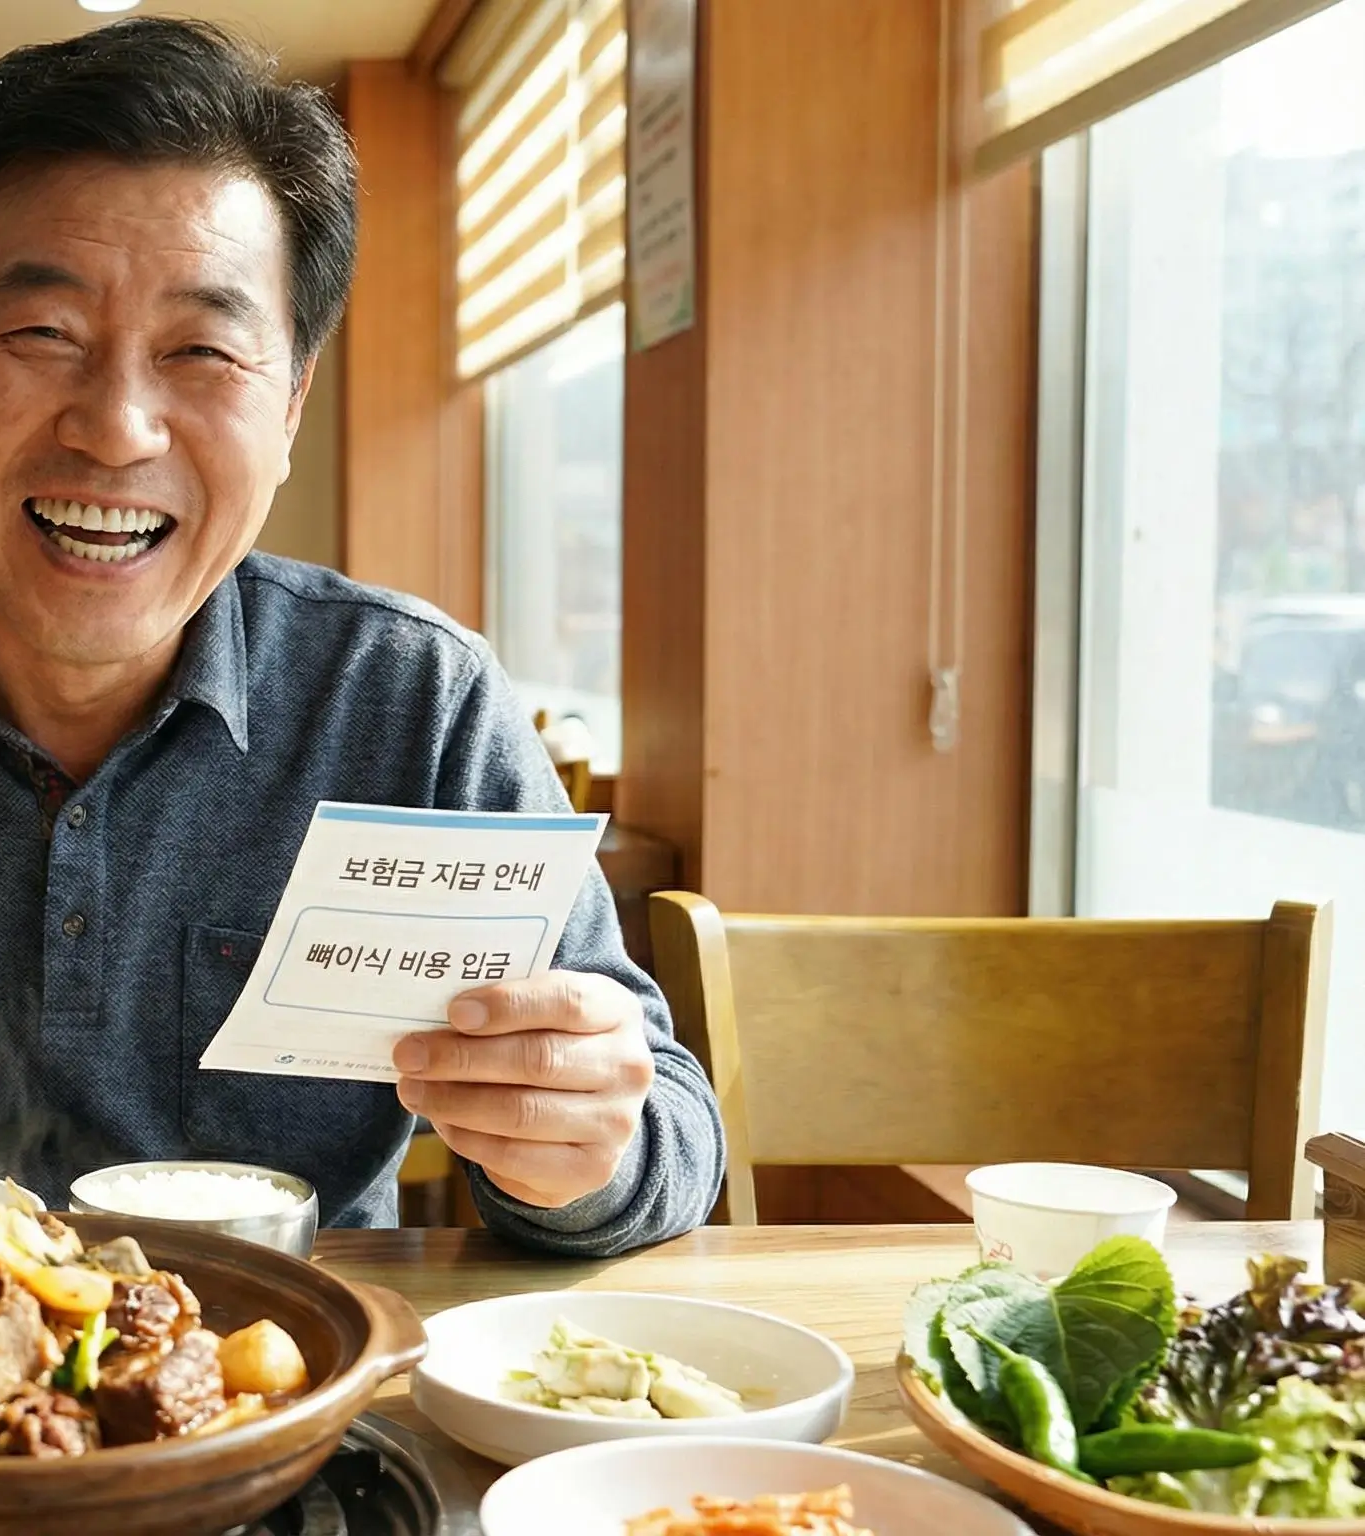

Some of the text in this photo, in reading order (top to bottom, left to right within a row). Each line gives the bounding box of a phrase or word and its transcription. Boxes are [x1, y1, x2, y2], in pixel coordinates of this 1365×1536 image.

[339, 857, 546, 892] 보험금 지급 안내
[305, 944, 511, 980] 뼈이식 비용 입금
